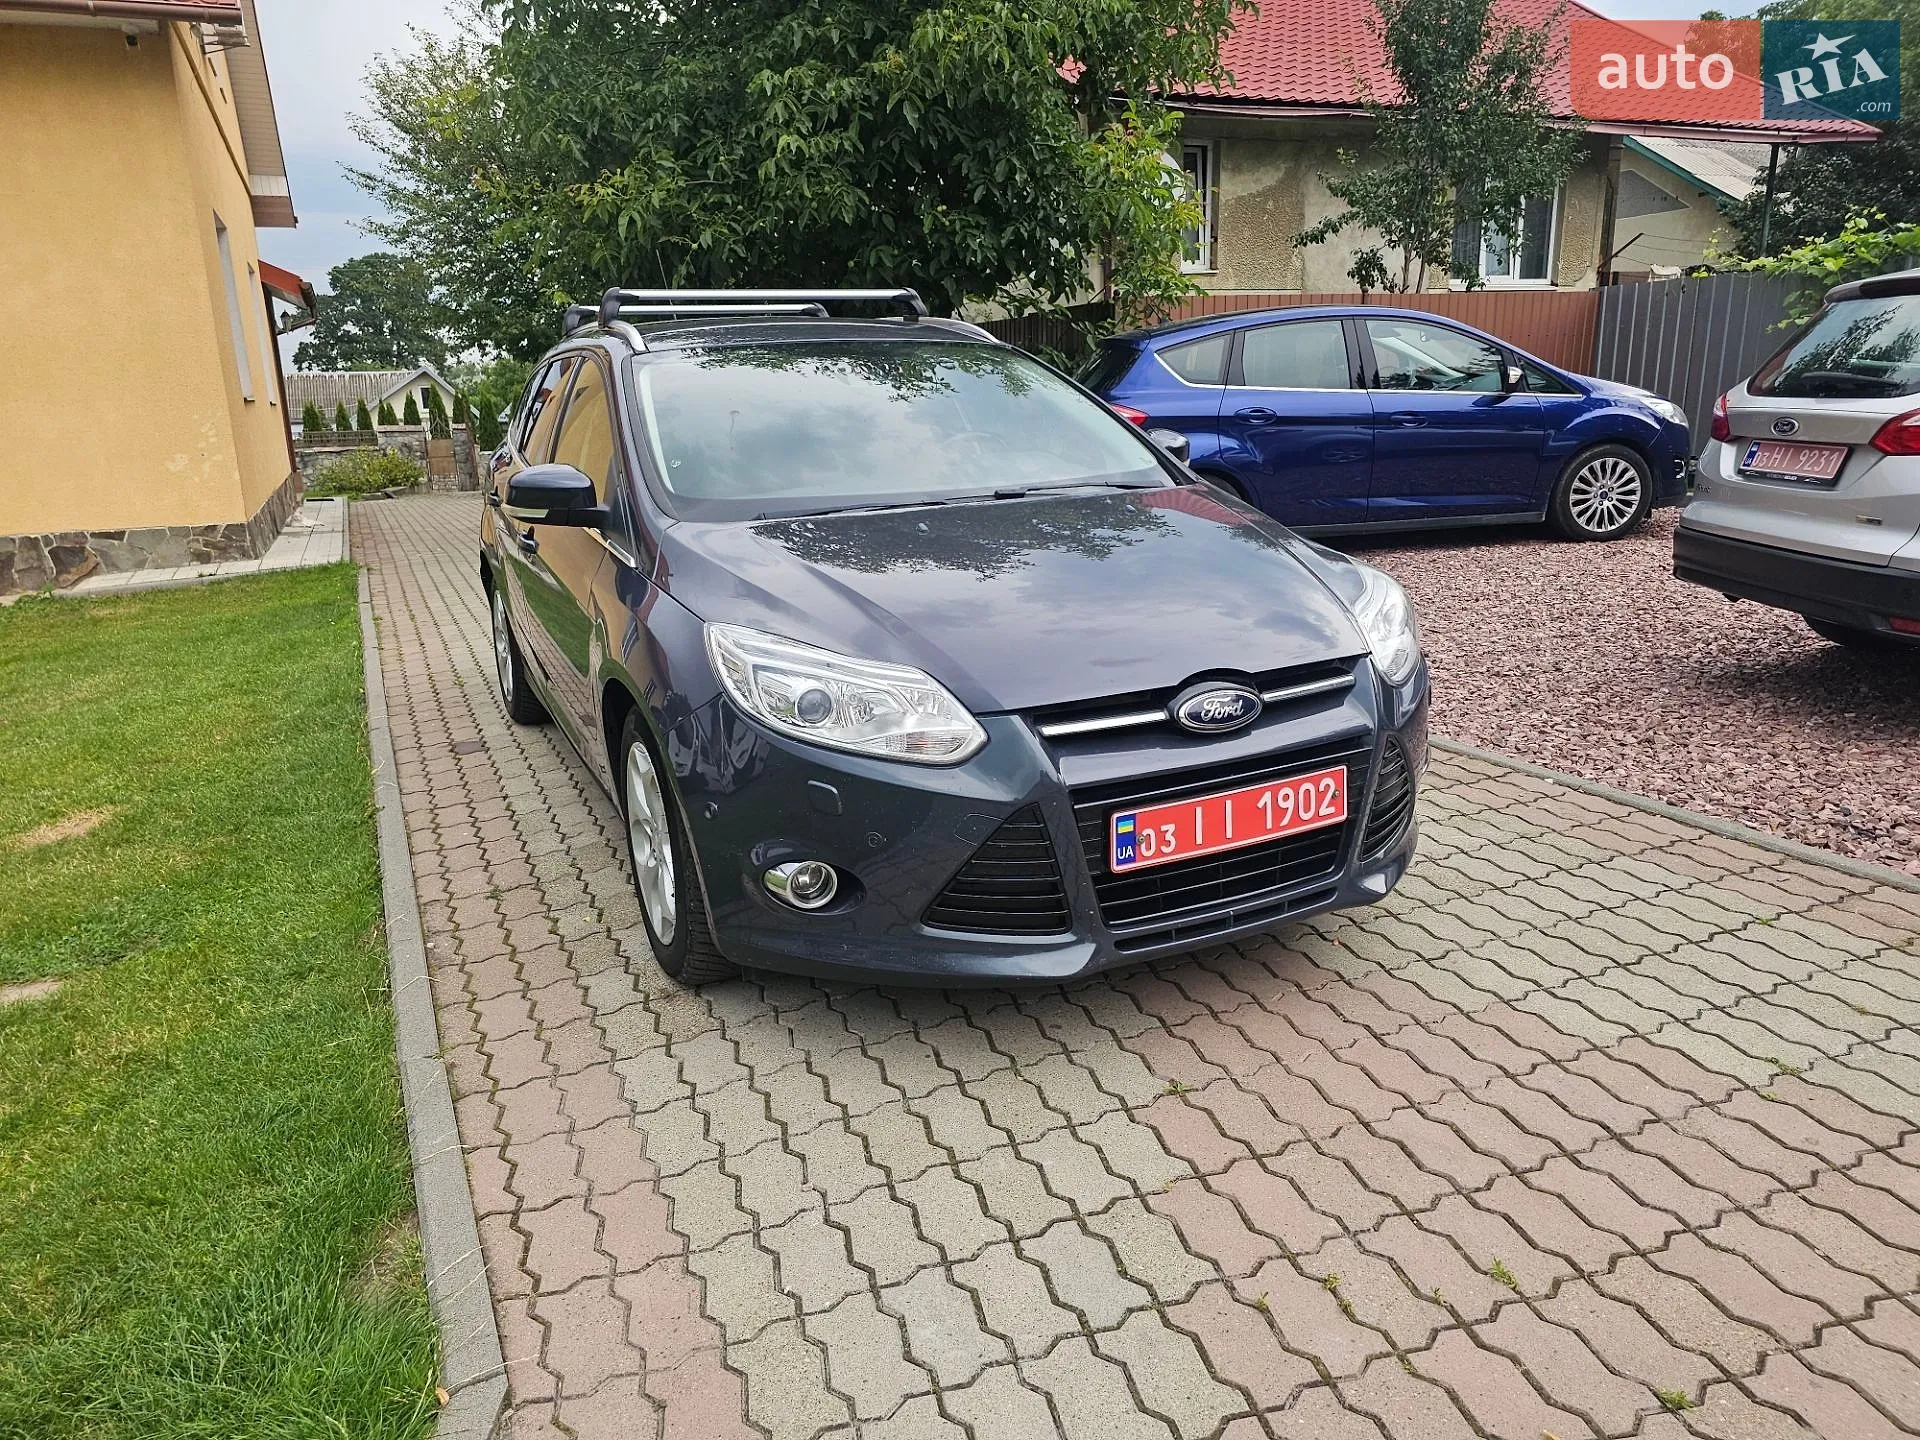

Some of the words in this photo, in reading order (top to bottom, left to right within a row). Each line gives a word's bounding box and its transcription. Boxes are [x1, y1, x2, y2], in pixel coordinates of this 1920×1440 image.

[1752, 452, 1770, 467] 03
[1795, 448, 1840, 473] 9231
[1201, 696, 1243, 722] Ford
[1139, 823, 1176, 857] 03
[1257, 777, 1337, 830] 1902
[1117, 845, 1134, 860] UA
